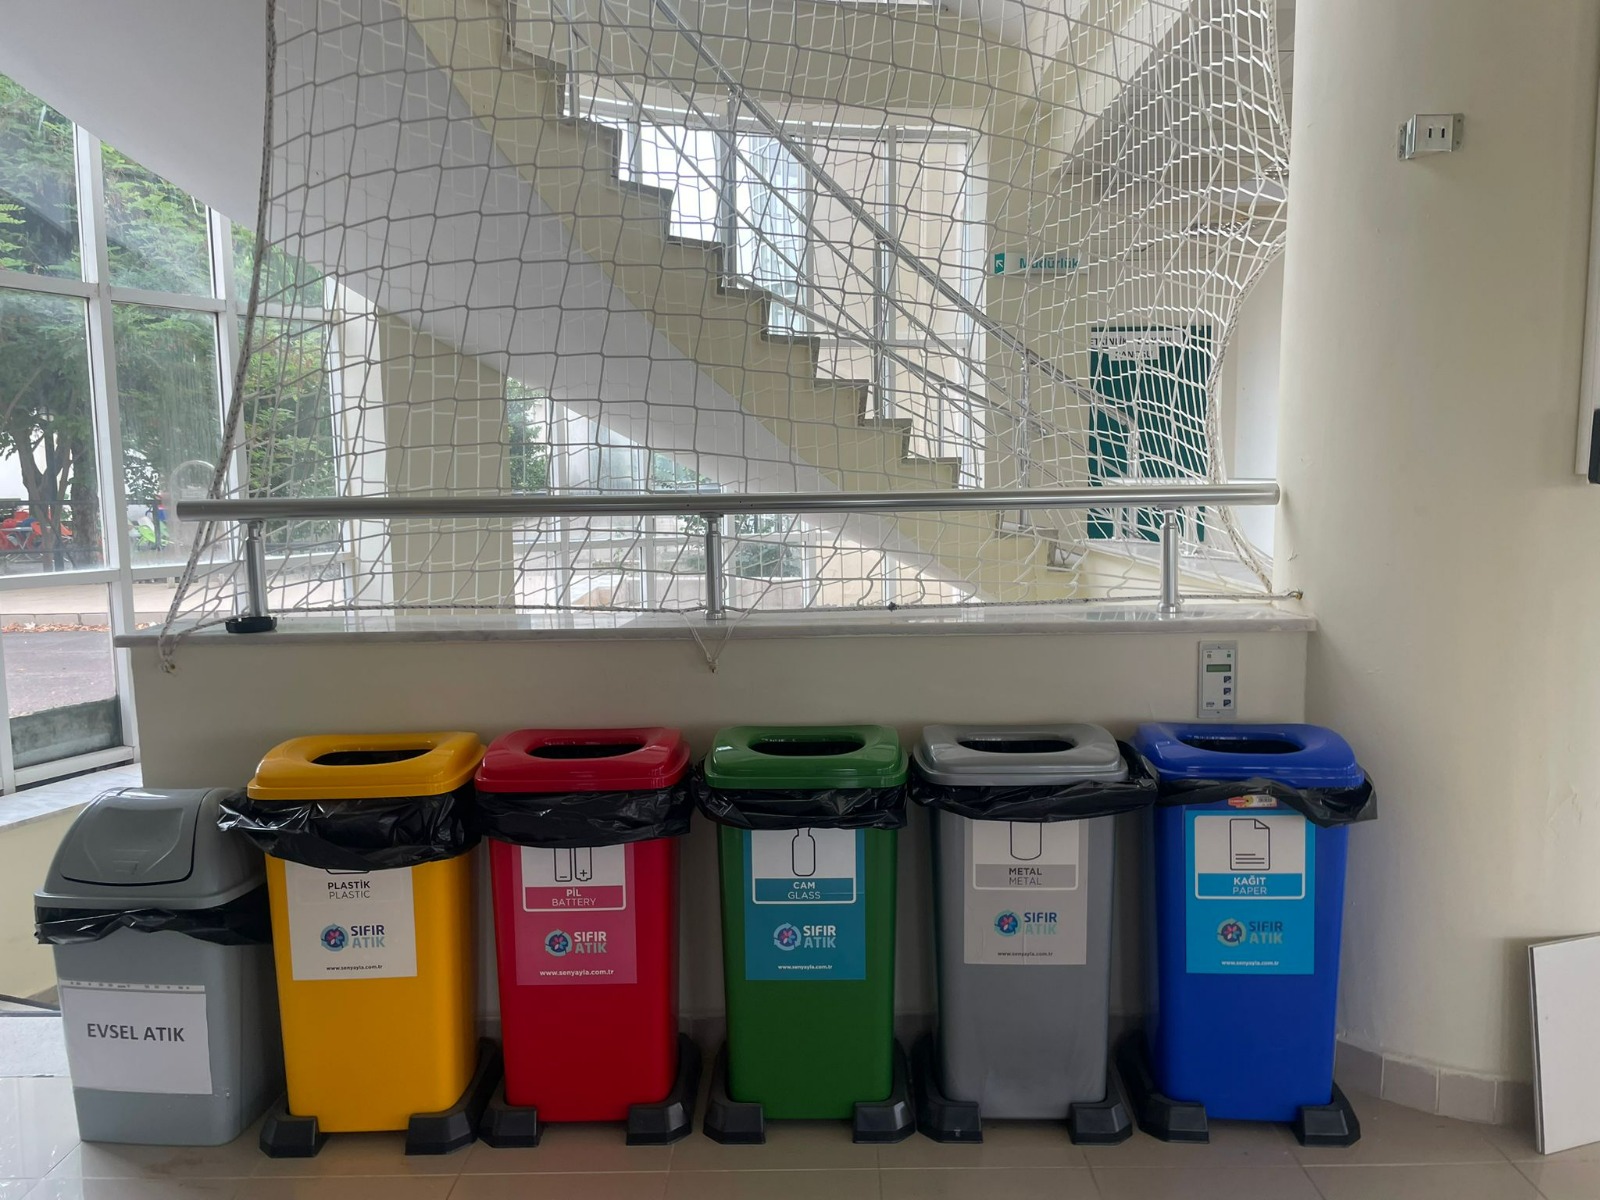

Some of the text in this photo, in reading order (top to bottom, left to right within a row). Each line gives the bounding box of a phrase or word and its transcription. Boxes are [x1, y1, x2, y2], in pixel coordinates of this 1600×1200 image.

[1019, 257, 1079, 269] Müdürlük
[1008, 867, 1043, 876] METAL
[327, 879, 371, 890] PLASTİK
[793, 881, 816, 890] CAM
[1008, 876, 1043, 886] METAL
[1233, 875, 1267, 885] KAĞIT
[328, 890, 371, 900] PLASTIC
[566, 887, 582, 897] PİL
[787, 891, 821, 900] GLASS
[1232, 886, 1268, 895] PAPER
[551, 898, 597, 907] BATTERY
[1024, 912, 1058, 923] SIFIR
[350, 924, 386, 936] SIFIR
[803, 925, 837, 936] SIFIR
[1025, 923, 1058, 935] ATIK
[1248, 921, 1284, 932] SIFIR
[573, 931, 608, 942] SIFIR
[1249, 932, 1284, 945] ATIK
[352, 936, 386, 949] ATIK
[574, 942, 608, 954] ATIK
[803, 936, 837, 949] ATIK
[87, 1023, 185, 1042] EVSEL ATIK
